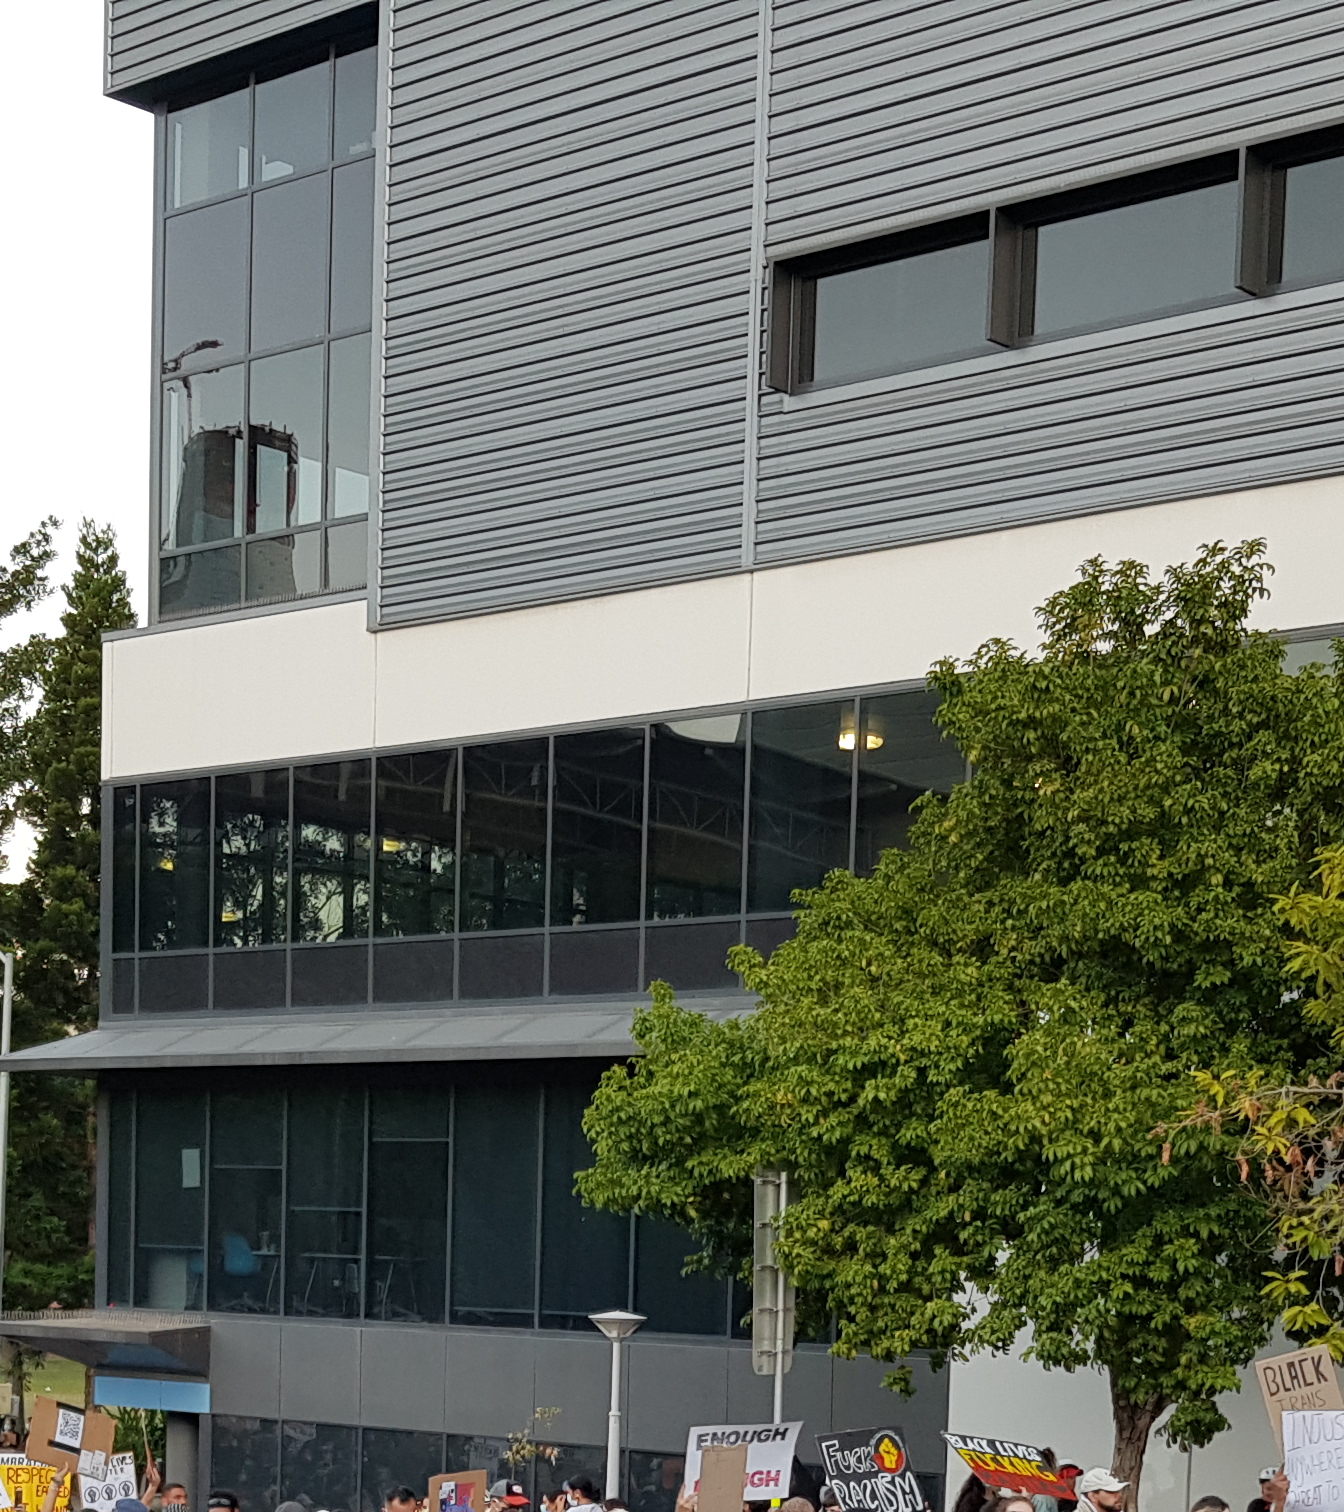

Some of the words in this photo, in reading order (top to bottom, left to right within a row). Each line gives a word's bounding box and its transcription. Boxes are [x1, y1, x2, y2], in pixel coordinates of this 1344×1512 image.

[1263, 1354, 1328, 1397] BLACK
[1275, 1390, 1326, 1412] TRANS
[696, 1427, 789, 1451] ENOUGH
[944, 1433, 995, 1455] BLACK
[994, 1441, 1042, 1462] LIVES
[821, 1440, 878, 1476] FUCK
[957, 1448, 1058, 1482] FUCKING
[6, 1466, 58, 1486] RESPEC
[1325, 1480, 1340, 1501] TO
